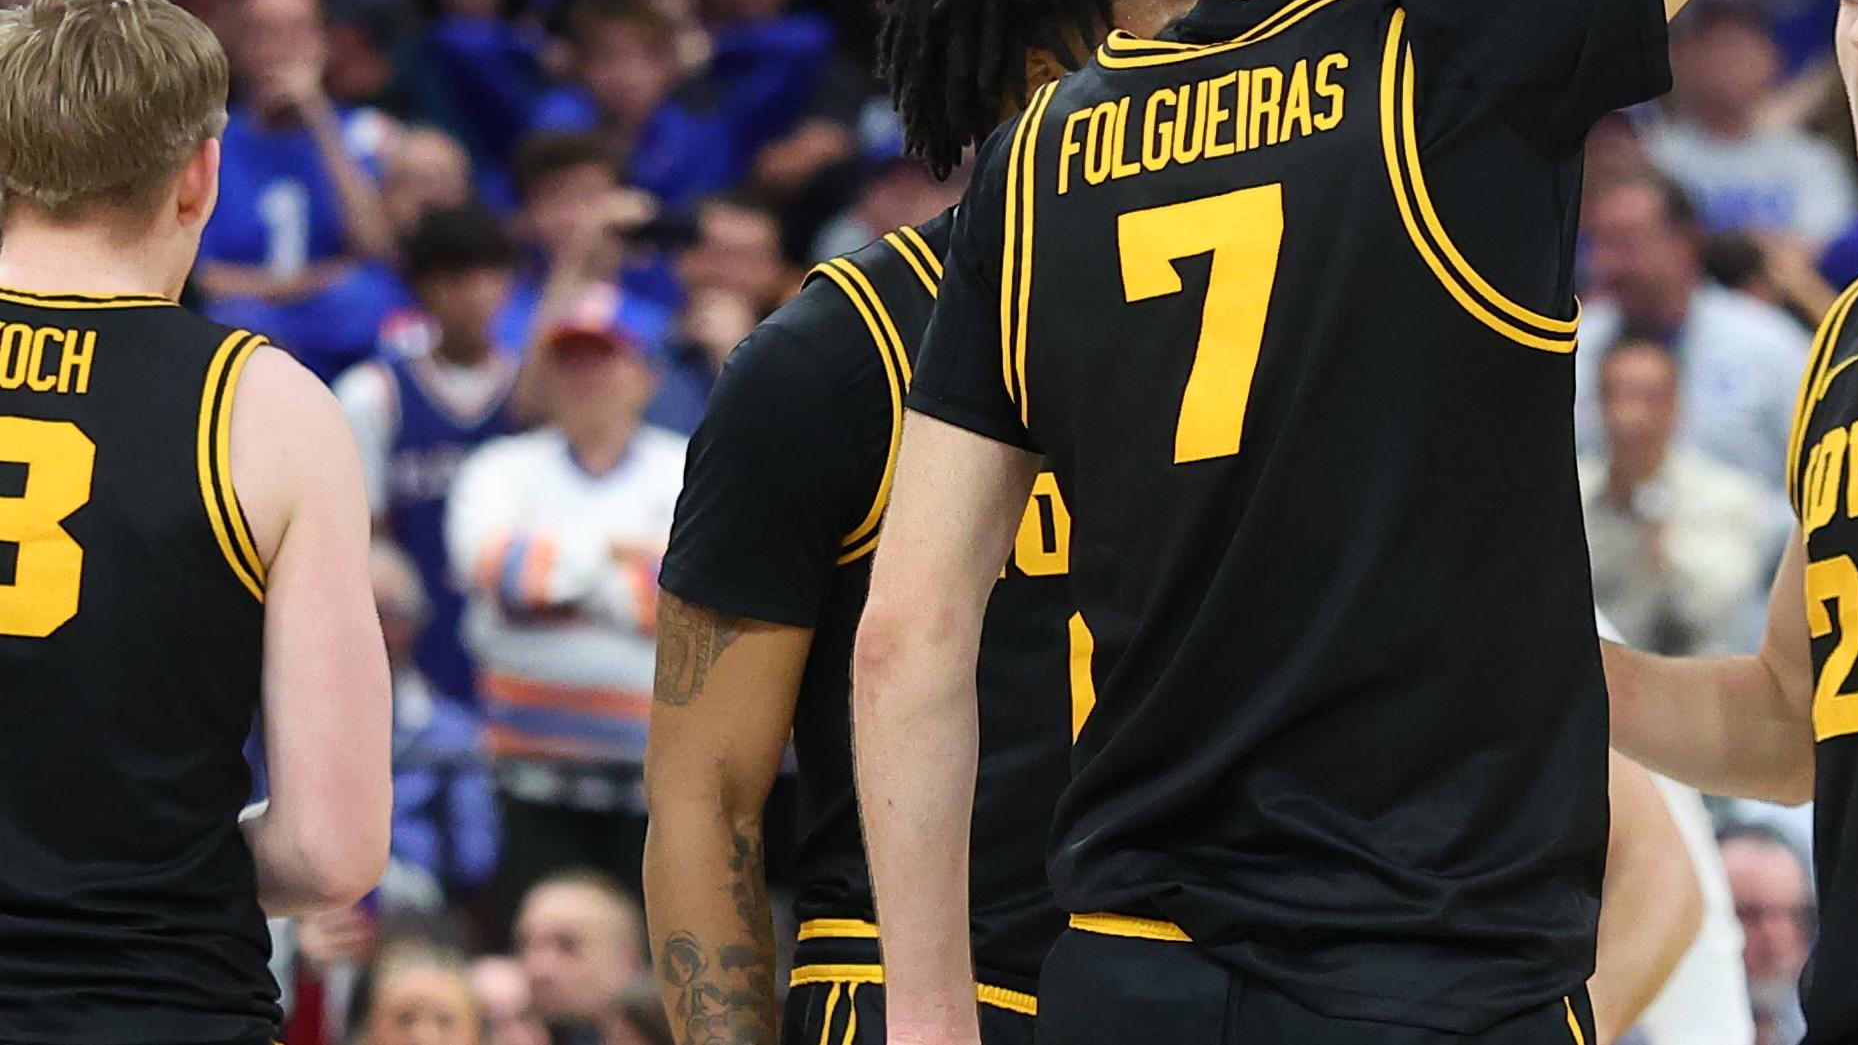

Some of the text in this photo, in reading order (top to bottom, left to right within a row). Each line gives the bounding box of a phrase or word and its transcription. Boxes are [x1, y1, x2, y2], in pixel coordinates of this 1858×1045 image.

[1056, 52, 1349, 195] FOLGUEIRAS
[0, 322, 97, 394] OCH
[1117, 182, 1285, 464] 7
